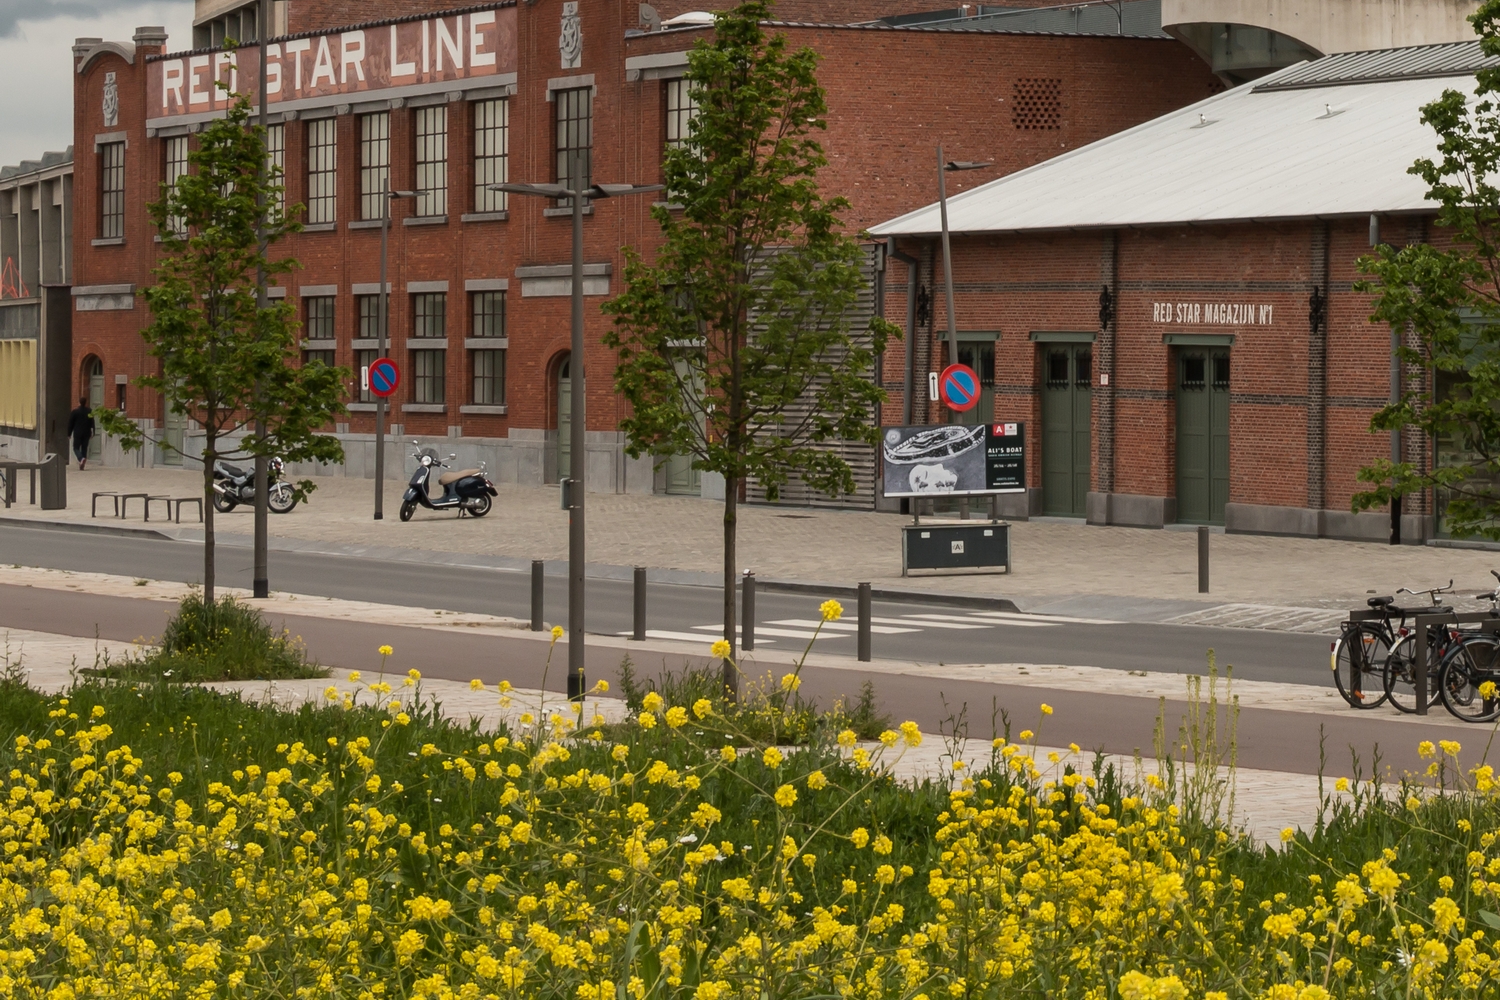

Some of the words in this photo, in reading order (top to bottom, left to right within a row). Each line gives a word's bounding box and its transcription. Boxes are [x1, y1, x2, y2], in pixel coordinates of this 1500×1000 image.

[162, 51, 237, 108] RED
[259, 30, 365, 94] STAR
[390, 11, 496, 77] LINE
[1153, 302, 1173, 323] RED
[1176, 303, 1201, 323] STAR
[1204, 303, 1255, 325] MAGAZIJN
